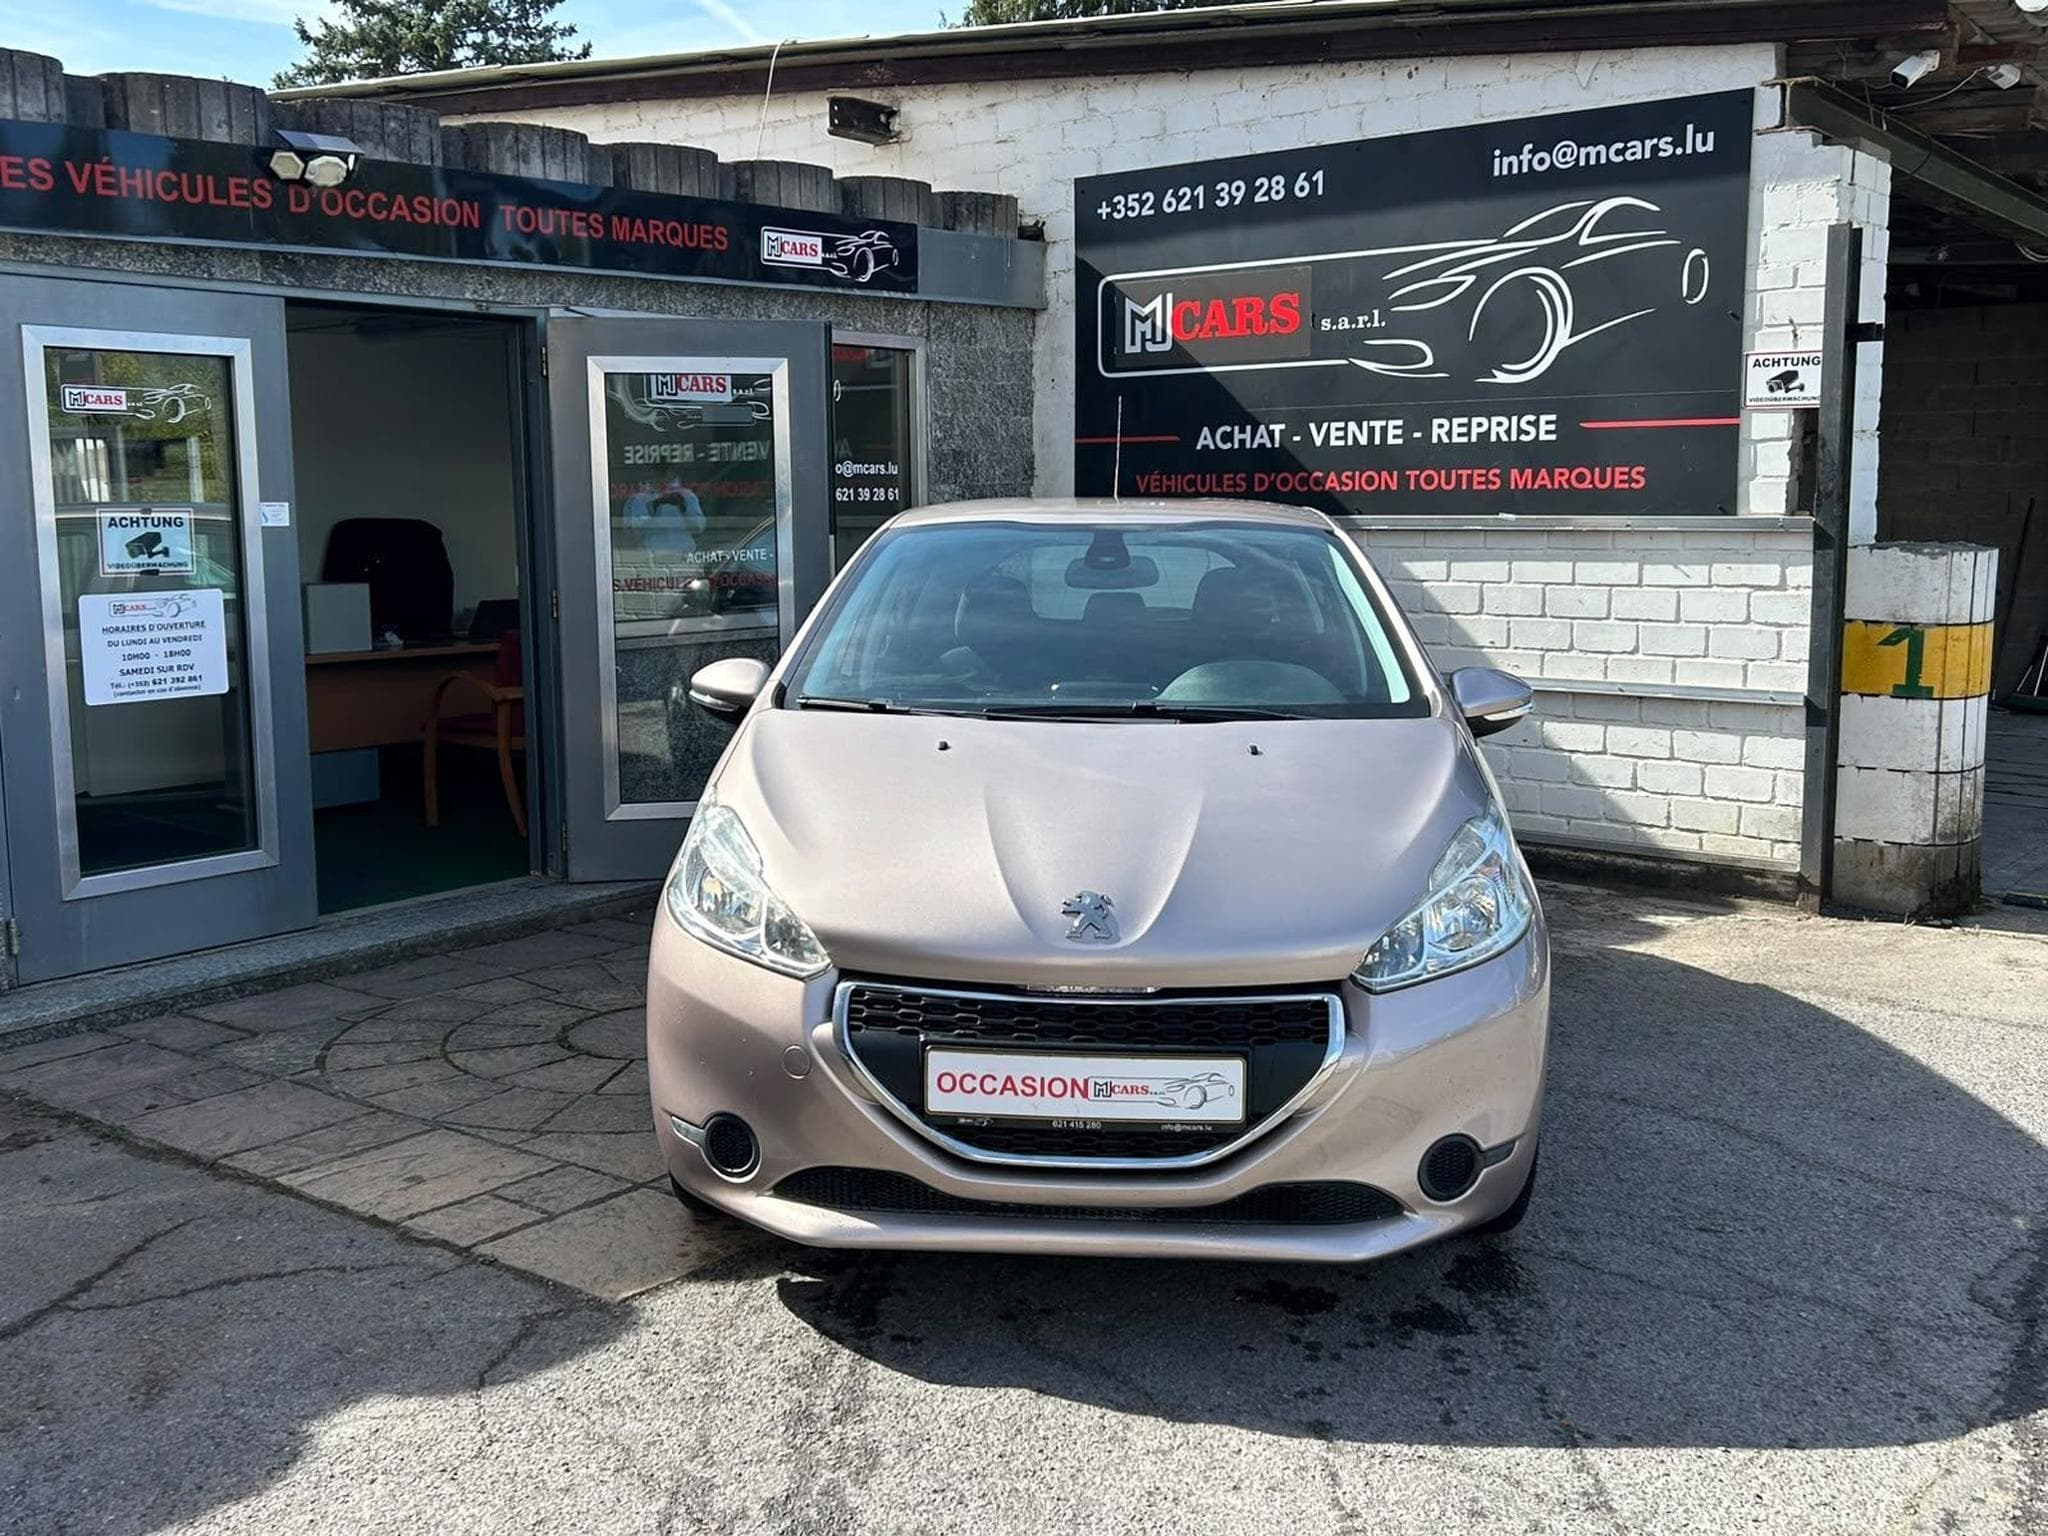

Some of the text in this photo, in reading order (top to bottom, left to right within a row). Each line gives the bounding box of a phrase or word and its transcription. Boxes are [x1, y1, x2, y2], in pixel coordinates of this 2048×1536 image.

[1493, 123, 1715, 177] info@mcars.lu
[1097, 170, 1324, 220] +352 621 39 28 61
[64, 156, 272, 209] VÉHICULES
[288, 184, 480, 228] D'OCCASION
[501, 204, 603, 239] TOUTES
[611, 215, 729, 251] MARQUES
[1320, 309, 1386, 331] s.a.r.l.
[1753, 356, 1820, 368] ACHTUNG
[1196, 424, 1286, 450] ACHAT
[1308, 419, 1404, 447] VENTE
[1431, 414, 1557, 443] REPRISE
[1136, 466, 1646, 493] VÉHICULES D'OCCASION TOUTES MARQUES
[835, 487, 899, 501] 621 39 28 61
[108, 517, 184, 528] ACHTUNG
[686, 552, 722, 564] ACHAT
[732, 549, 768, 562] VENTE
[102, 625, 146, 634] HORAIRES
[121, 638, 147, 646] LUNDI
[149, 637, 160, 645] AU
[162, 634, 202, 644] VENDREDI
[122, 652, 150, 661] 10H00
[163, 649, 191, 658] 18H00
[119, 663, 195, 676] SAMEDI SUR RDV
[1878, 627, 1934, 698] 1
[151, 677, 167, 686] 621
[937, 1072, 1088, 1099] OCCASION
[1052, 1120, 1067, 1128] 621
